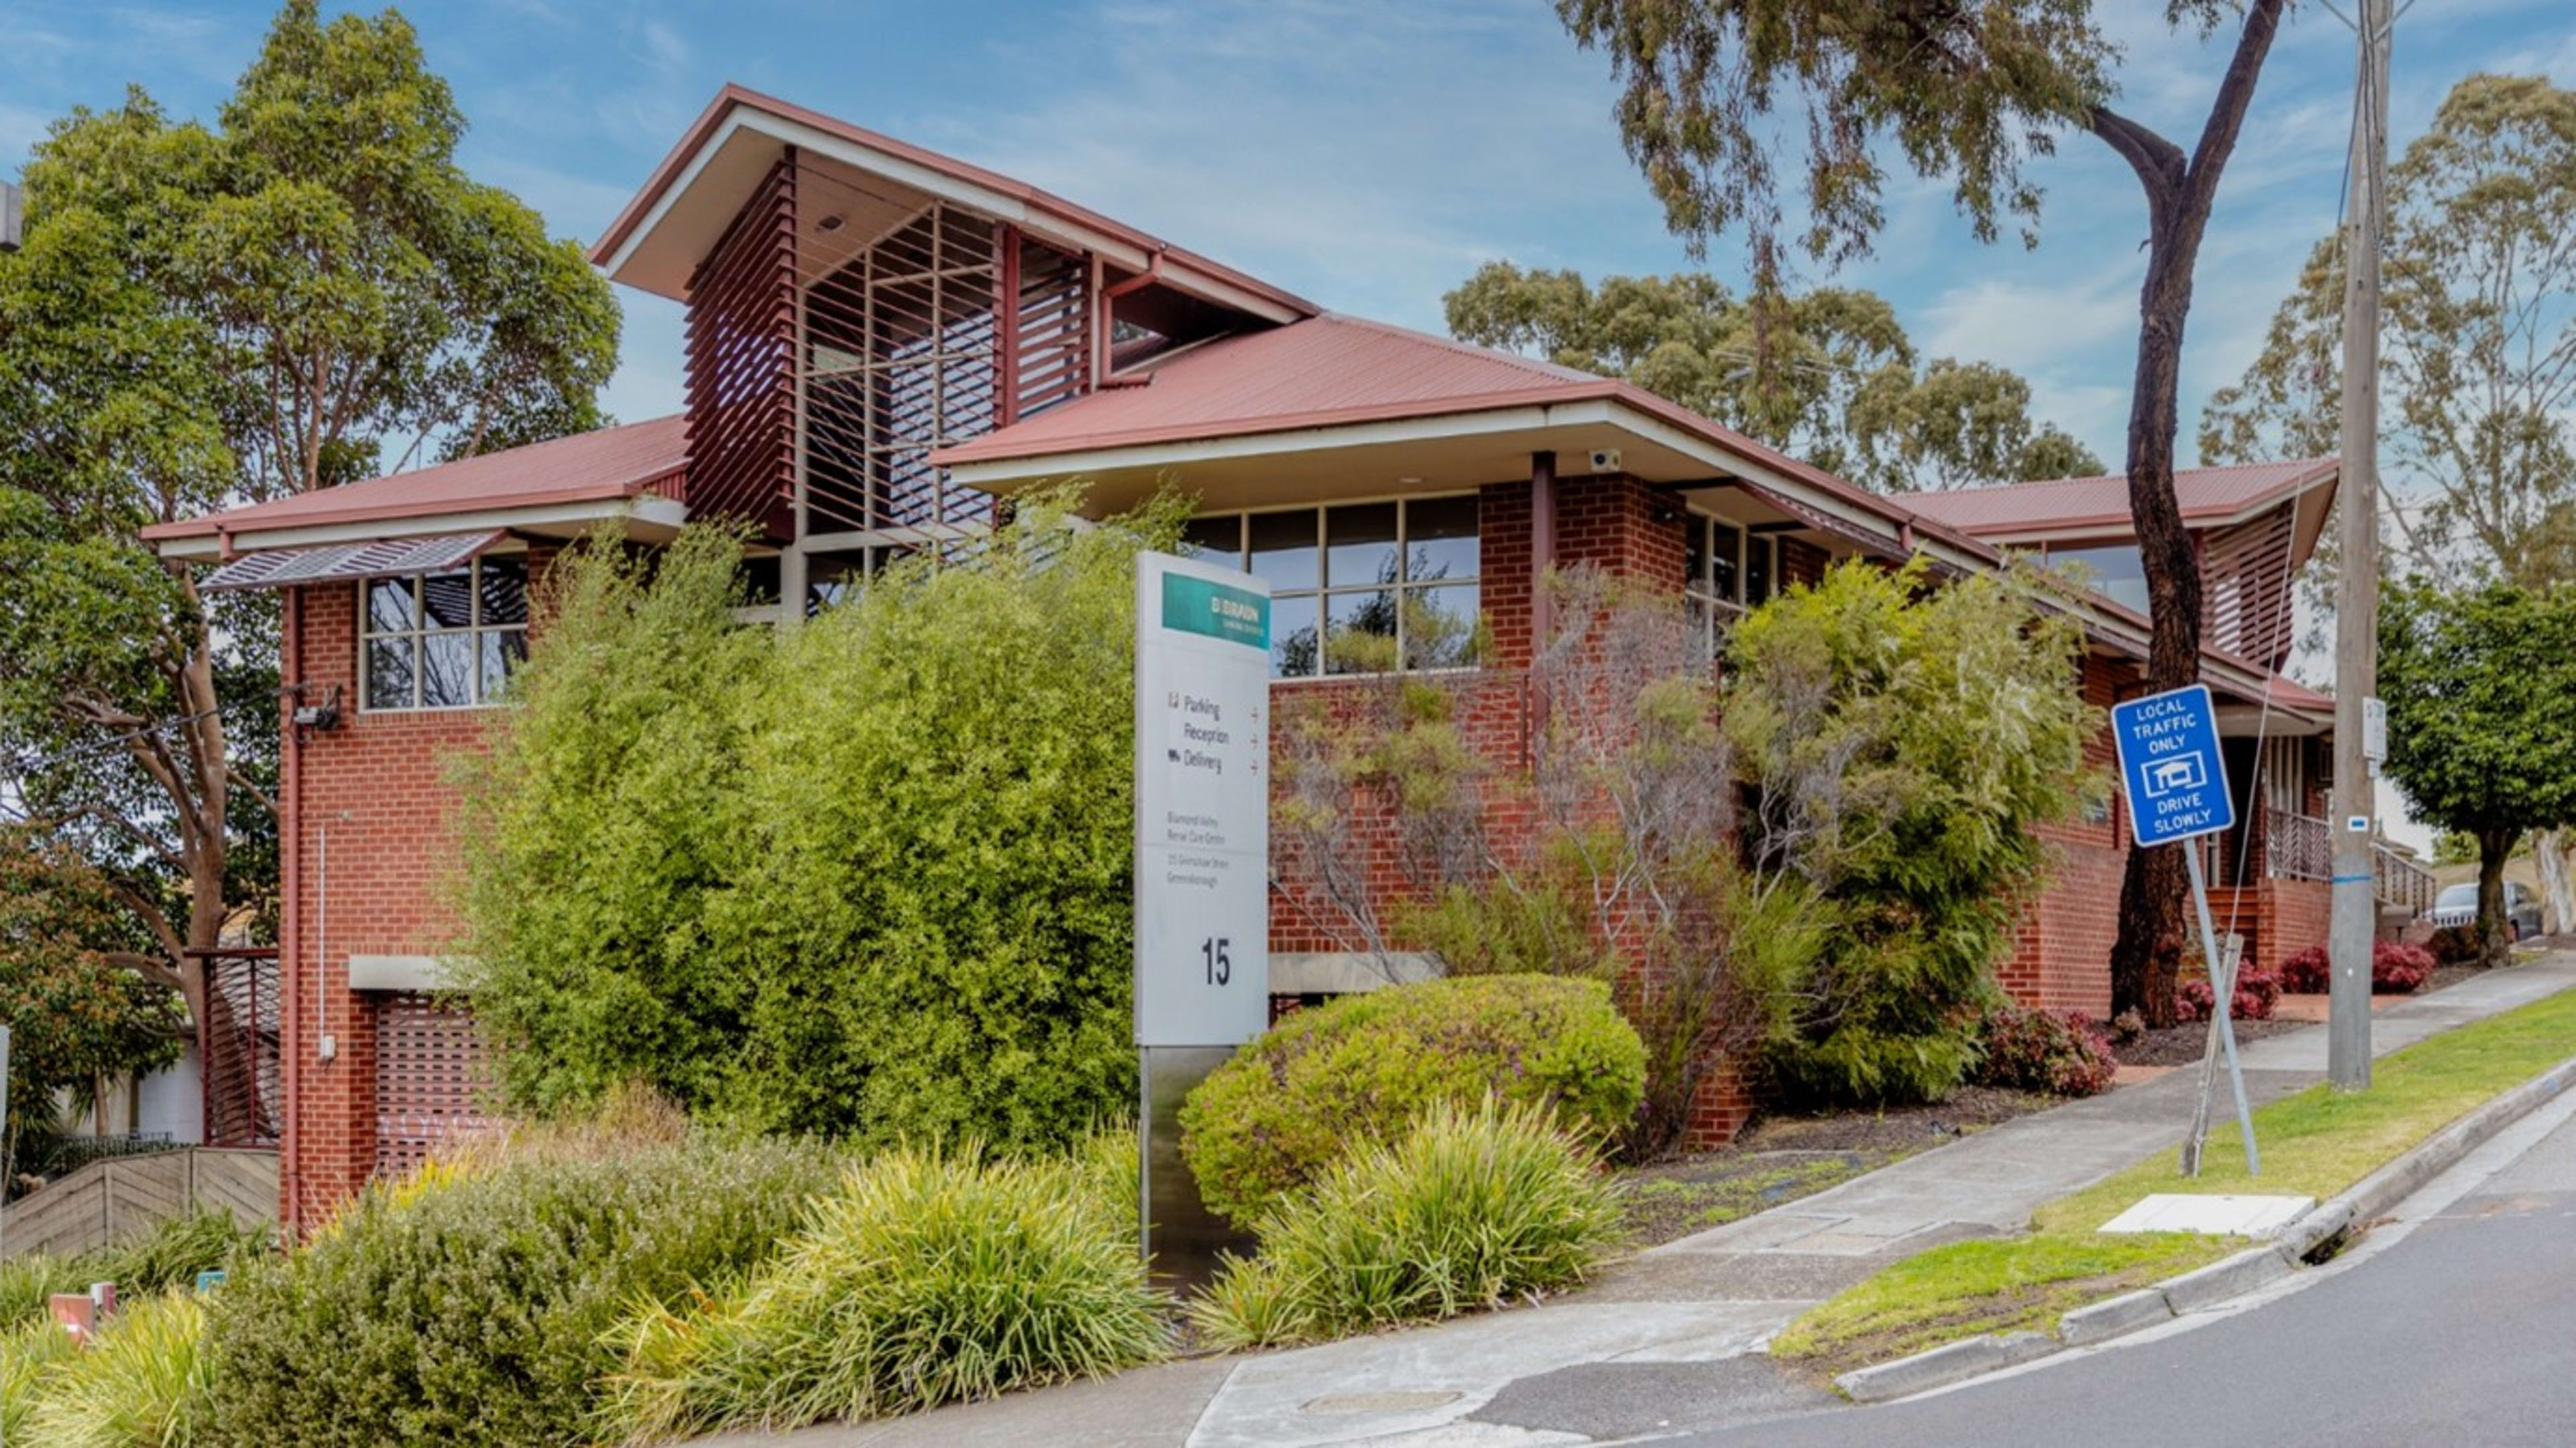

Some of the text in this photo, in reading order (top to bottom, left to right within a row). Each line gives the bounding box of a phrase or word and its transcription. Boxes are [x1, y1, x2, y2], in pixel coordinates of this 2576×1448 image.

[1184, 695, 1220, 721] Parking
[2136, 699, 2186, 721] LOCAL
[1184, 723, 1230, 745] Reception
[2133, 713, 2197, 740] TRAFFIC
[2149, 733, 2186, 754] ONLY
[1184, 749, 1222, 775] Delivery
[2157, 792, 2202, 815] DRIVE
[2154, 808, 2211, 833] SLOWLY
[1202, 937, 1230, 986] 15
